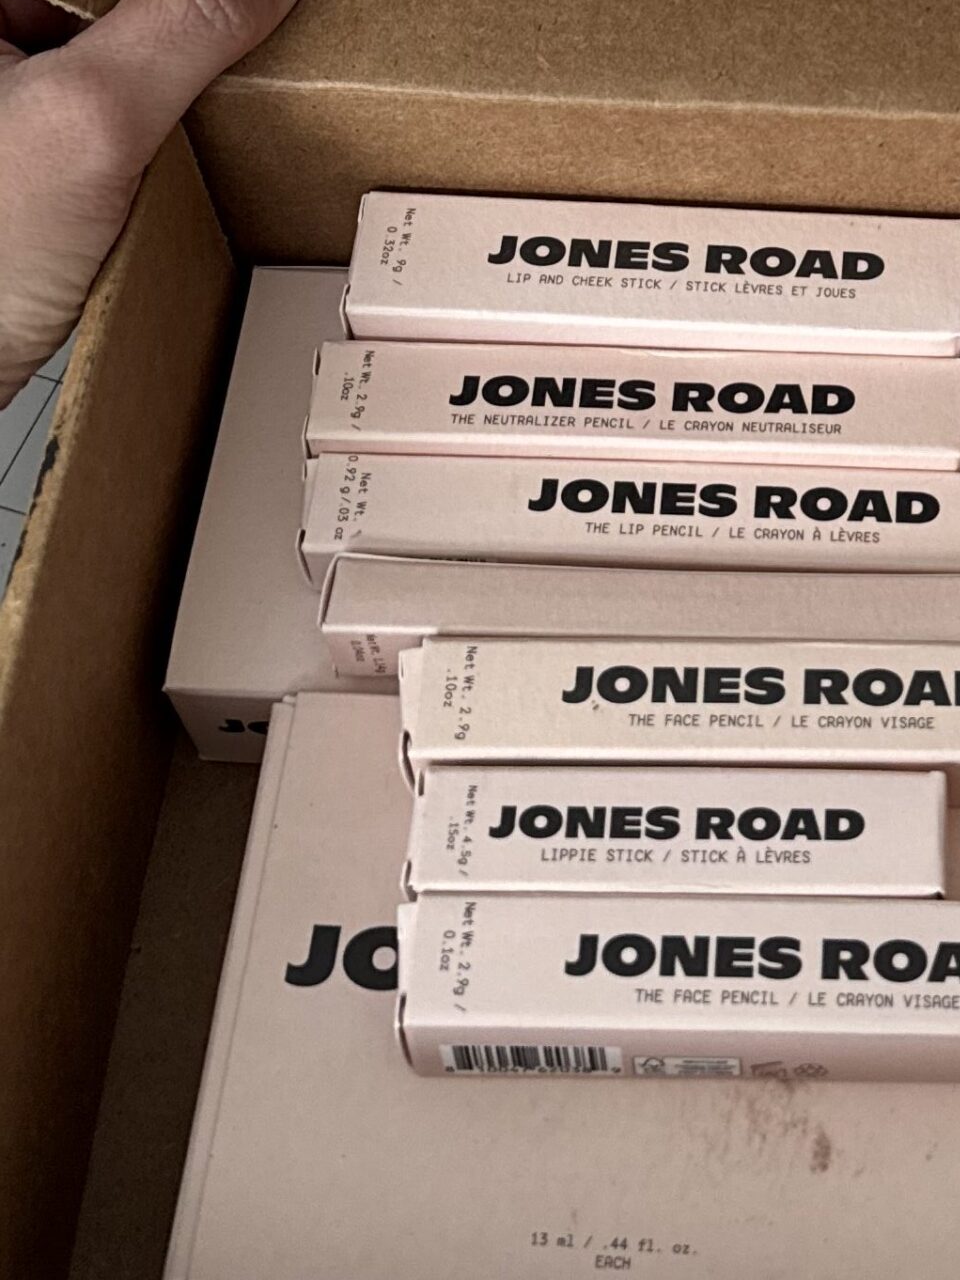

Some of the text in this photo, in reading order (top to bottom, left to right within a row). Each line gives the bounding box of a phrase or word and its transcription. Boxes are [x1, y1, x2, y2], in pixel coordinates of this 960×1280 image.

[403, 207, 416, 227] Net
[380, 226, 398, 265] 0.32oz
[488, 236, 884, 280] JONES ROAD
[392, 259, 407, 273] 9g
[507, 273, 531, 283] LIP
[539, 274, 563, 285] AND
[572, 276, 612, 287] CHEEK
[621, 278, 661, 289] STICK
[686, 281, 726, 292] STICK
[735, 281, 782, 295] LÈVRES
[792, 286, 807, 296] ET
[816, 287, 856, 299] JOUES
[362, 350, 375, 368] Net
[350, 394, 368, 419] 2.9g
[449, 376, 855, 415] JONES ROAD
[452, 414, 475, 424] THE
[484, 414, 575, 427] NEUTRALIZER
[584, 417, 634, 429] PENCIL
[660, 420, 675, 430] LE
[684, 421, 733, 432] CRAYON
[742, 422, 841, 434] NEUTRALISEUR
[344, 455, 358, 482] 0.92
[358, 472, 372, 494] Net
[528, 479, 940, 524] JONES ROAD
[586, 522, 610, 534] THE
[619, 523, 644, 535] LIP
[653, 524, 703, 537] PENCIL
[729, 527, 745, 539] LE
[754, 528, 804, 540] CRAYON
[830, 527, 880, 543] LÈVRES
[443, 669, 458, 707] .10oz
[454, 646, 478, 740] Net Wt. 2.9g
[562, 666, 785, 705] JONES
[629, 714, 654, 726] THE
[665, 714, 700, 727] FACE
[709, 714, 763, 727] PENCIL
[791, 715, 808, 728] LE
[818, 716, 872, 728] CRAYON
[881, 717, 934, 729] VISAGE
[466, 785, 478, 806] Net
[489, 805, 865, 841] JONES ROAD
[541, 848, 596, 862] LIPPIE
[606, 849, 653, 862] STICK
[681, 850, 727, 863] STICK
[756, 847, 810, 864] LÈVRES
[462, 901, 477, 926] Net
[440, 930, 456, 971] 0.1oz
[565, 934, 802, 980] JONES
[453, 962, 471, 996] 2.9g
[635, 988, 663, 1003] THE
[674, 989, 711, 1004] FACE
[721, 990, 778, 1005] PENCIL
[808, 992, 826, 1007] LE
[837, 993, 893, 1008] CRAYON
[904, 994, 960, 1010] VISAGE
[531, 1232, 548, 1246] 13
[556, 1234, 574, 1248] ml
[603, 1237, 628, 1250] .44
[595, 1255, 631, 1269] EACH
